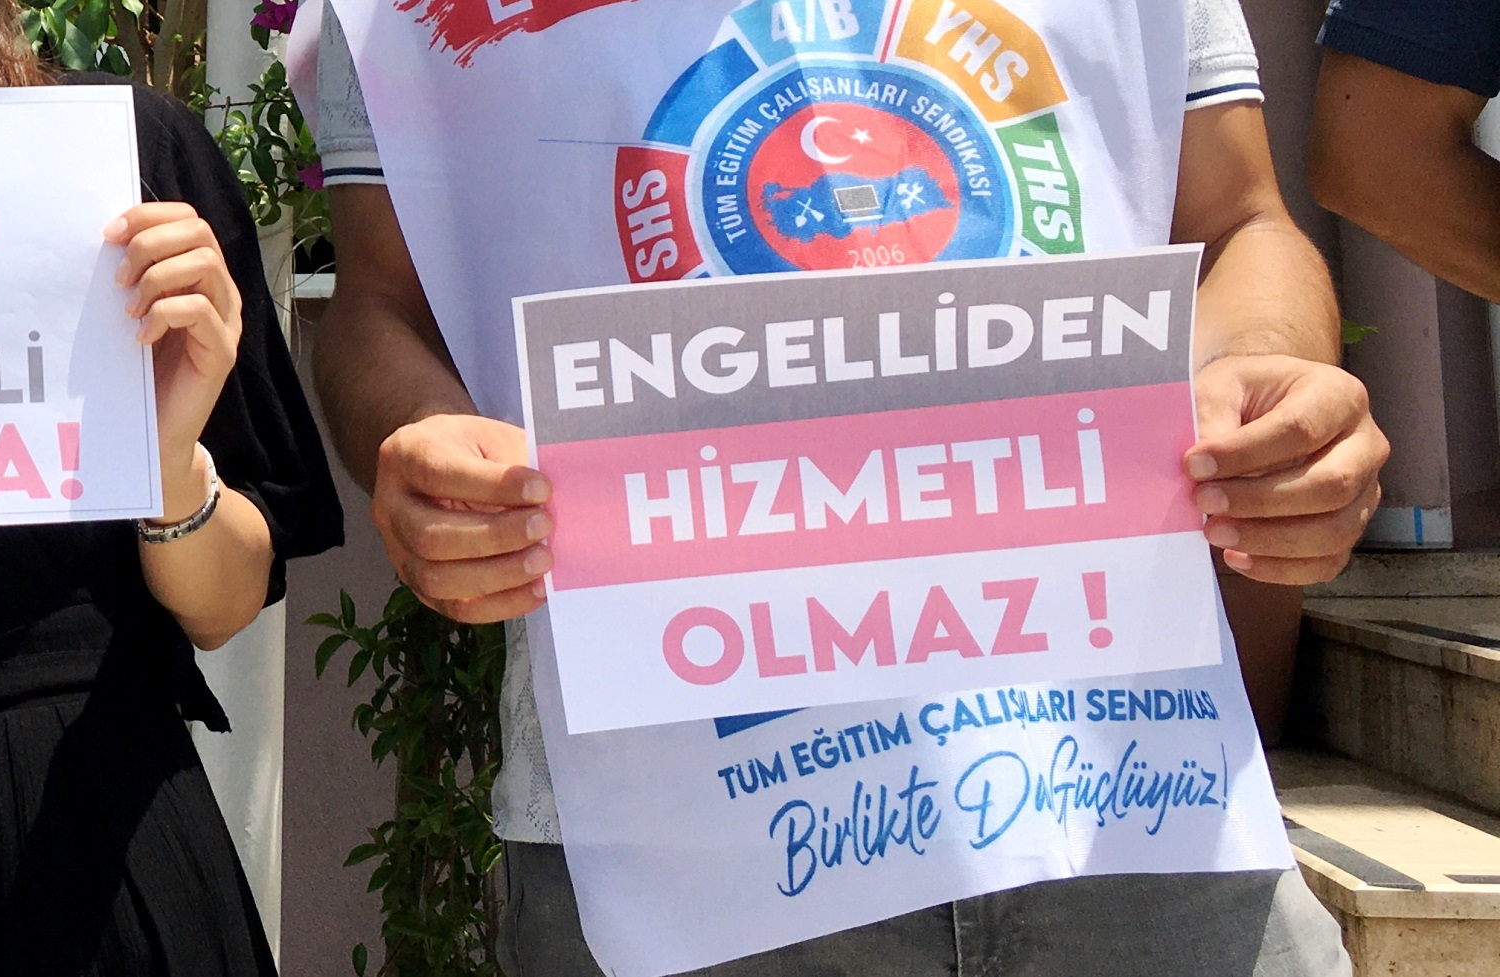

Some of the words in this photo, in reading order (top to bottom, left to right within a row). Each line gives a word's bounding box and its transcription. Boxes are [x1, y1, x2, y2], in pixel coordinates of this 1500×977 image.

[758, 77, 906, 123] ÇALIŞANLARI
[911, 95, 992, 197] SENDİKASI
[712, 118, 763, 186] EĞİTİM
[1012, 140, 1076, 245] THS
[621, 168, 679, 272] SHS
[715, 195, 747, 244] TÜM
[849, 243, 906, 268] 2006
[552, 290, 1171, 410] ENGELLİDEN
[624, 408, 1107, 545] HİZMETLİ
[662, 577, 1049, 686] OLMAZ
[791, 712, 912, 777] EĞİTİM
[769, 765, 942, 897] Birlikte
